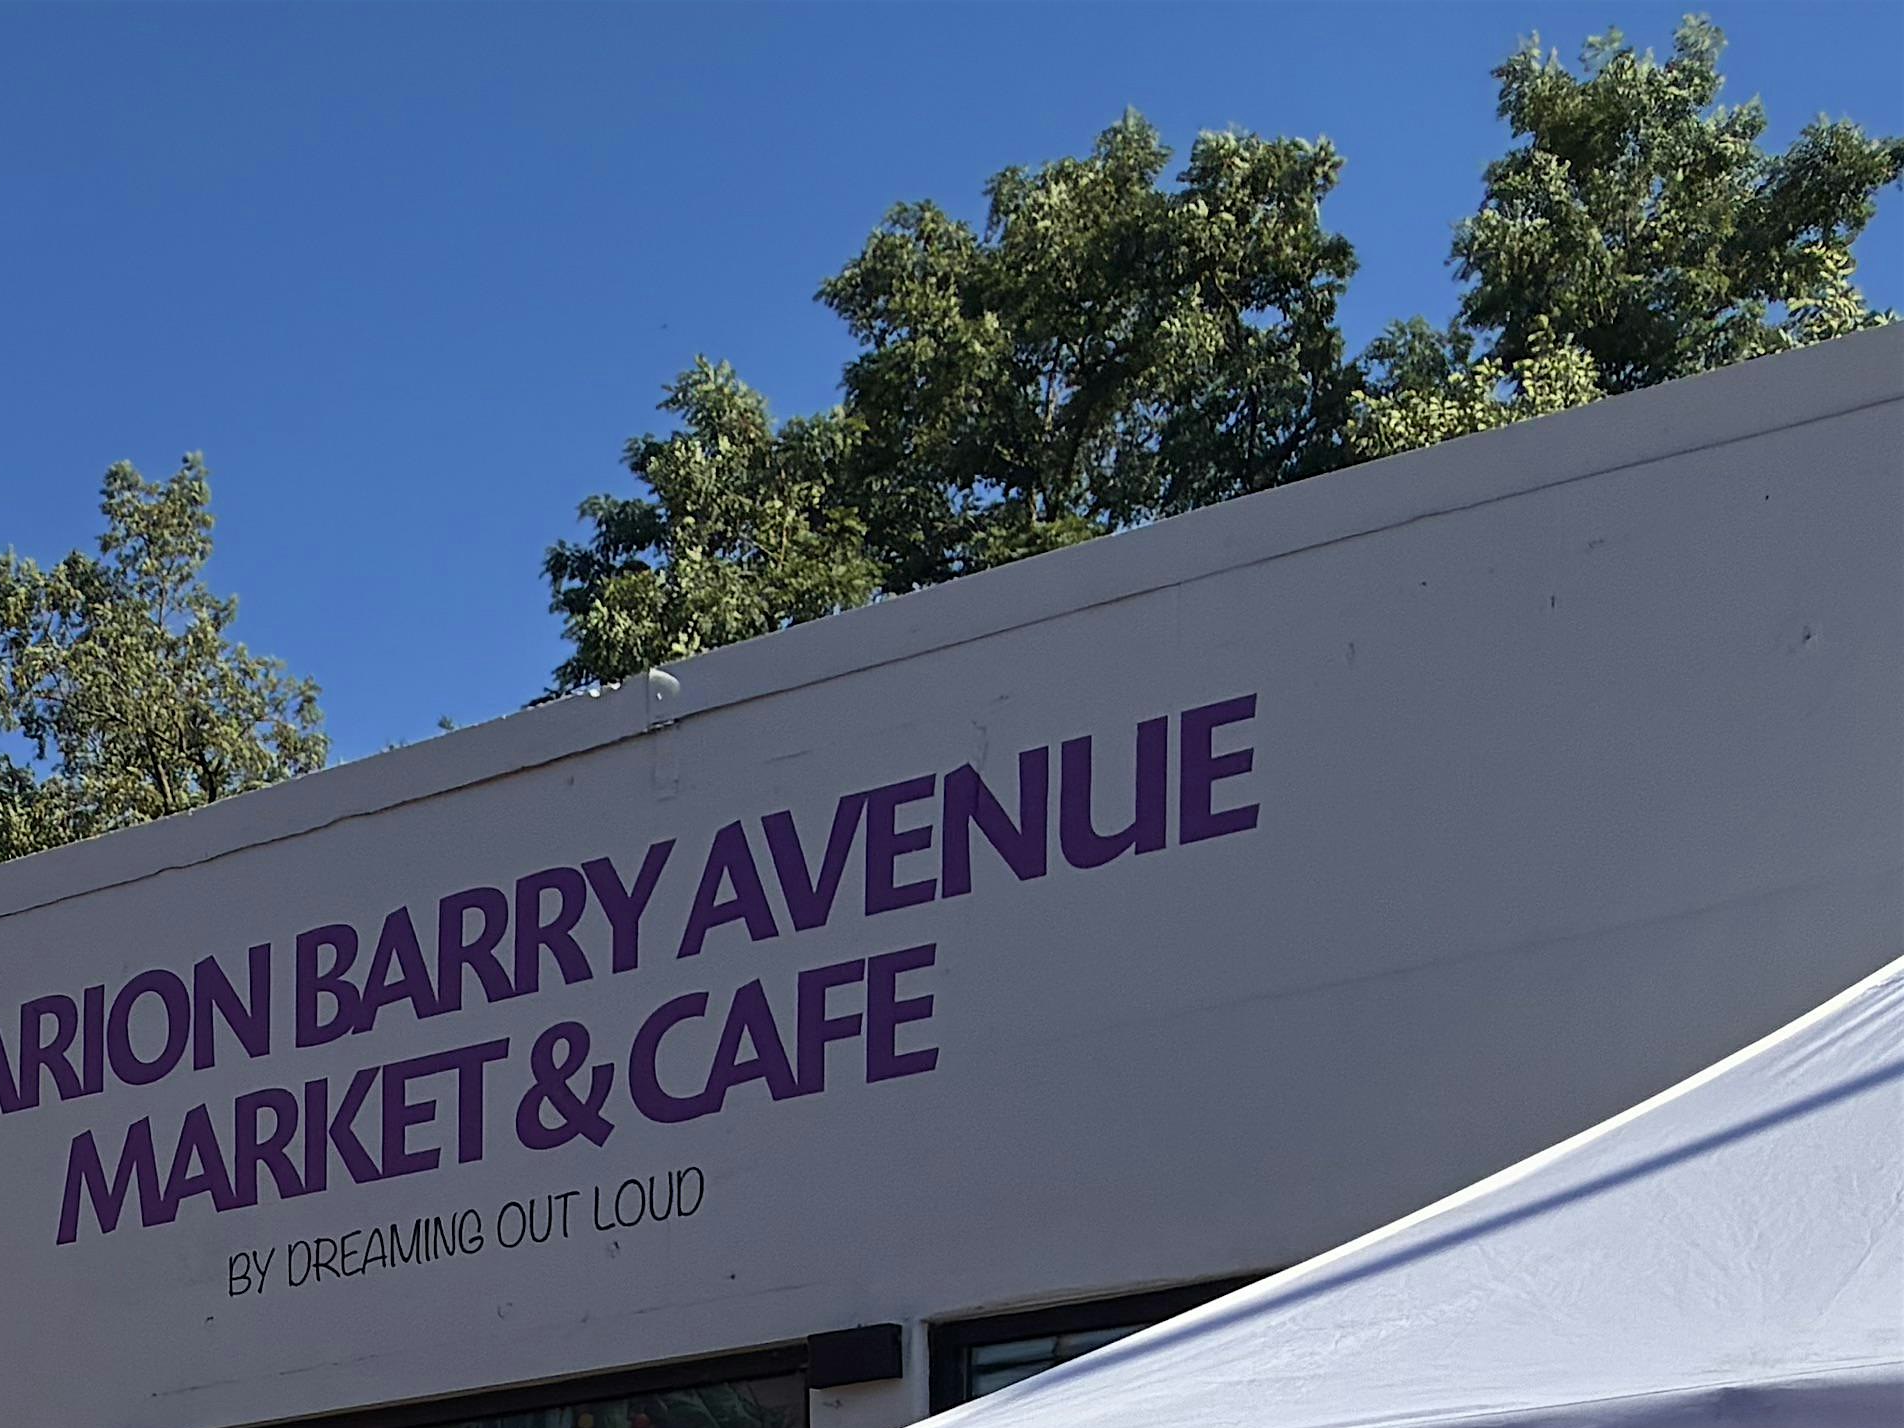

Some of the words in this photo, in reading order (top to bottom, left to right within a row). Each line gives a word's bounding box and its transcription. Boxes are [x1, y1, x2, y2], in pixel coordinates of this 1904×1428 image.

[295, 838, 676, 1048] BARRY
[677, 693, 1260, 959] AVENUE
[56, 1037, 510, 1245] MARKET
[514, 1021, 615, 1151] &
[629, 943, 939, 1123] CAFE
[228, 1247, 275, 1297] BY
[287, 1209, 485, 1287] DREAMING
[497, 1191, 580, 1248] OUT
[593, 1166, 704, 1232] LOUD
